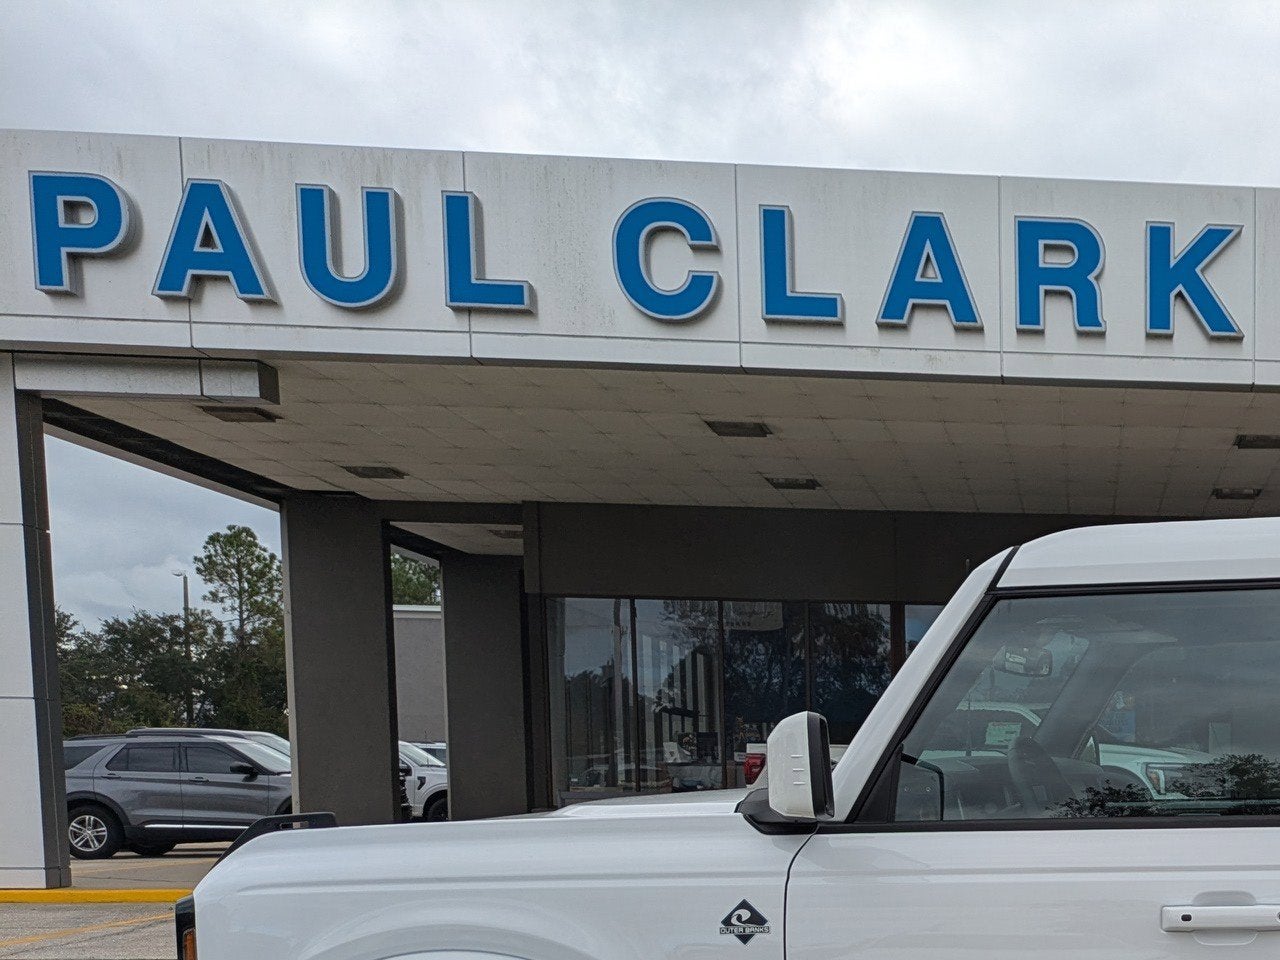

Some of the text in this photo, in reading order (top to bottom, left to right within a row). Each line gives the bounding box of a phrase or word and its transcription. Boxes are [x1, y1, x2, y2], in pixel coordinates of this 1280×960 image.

[28, 169, 1244, 340] PAUL CLARK
[720, 926, 769, 934] OUTER BANKS
